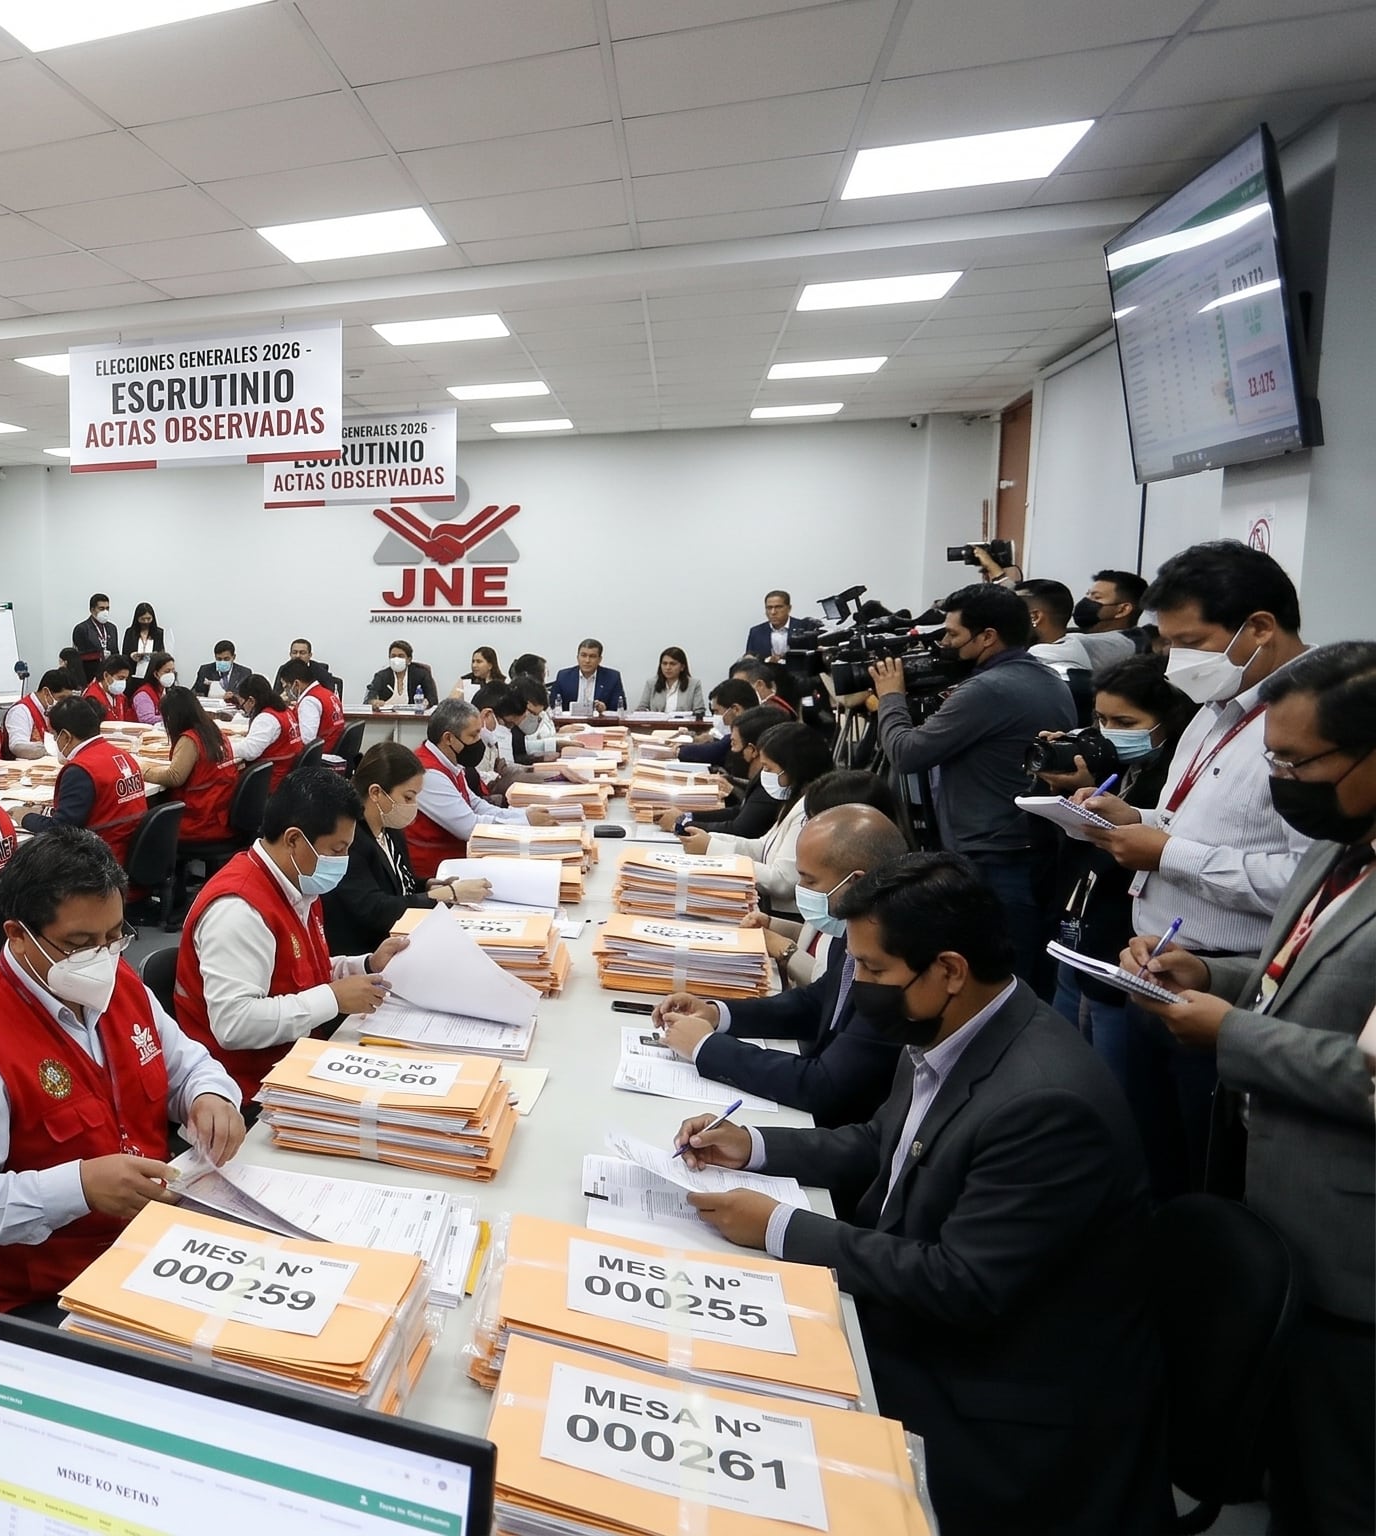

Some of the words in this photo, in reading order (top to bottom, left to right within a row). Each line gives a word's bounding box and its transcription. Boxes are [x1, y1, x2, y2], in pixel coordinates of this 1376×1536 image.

[95, 352, 175, 377] ELECCIONES
[179, 345, 259, 369] GENERALES
[262, 341, 301, 362] 2026
[112, 368, 294, 415] ESCRUTINIO
[85, 418, 157, 449] ACTAS
[164, 407, 325, 443] OBSERVADAS
[342, 424, 397, 439] GENERALES
[401, 422, 428, 435] 2026
[294, 439, 424, 469] RUTINIO
[273, 472, 325, 492] ACTAS
[331, 466, 445, 490] OBSERVADAS
[382, 567, 508, 607] JNE
[406, 615, 451, 624] NACIONAL
[453, 615, 464, 623] DE
[467, 615, 522, 623] ELECCIONES
[327, 1062, 437, 1086] 000260
[181, 1239, 266, 1271] MESA
[598, 1255, 694, 1286] MESA
[152, 1258, 316, 1311] 000259
[584, 1275, 768, 1327] 000255
[584, 1385, 701, 1429] MESA
[566, 1414, 787, 1490] 000261
